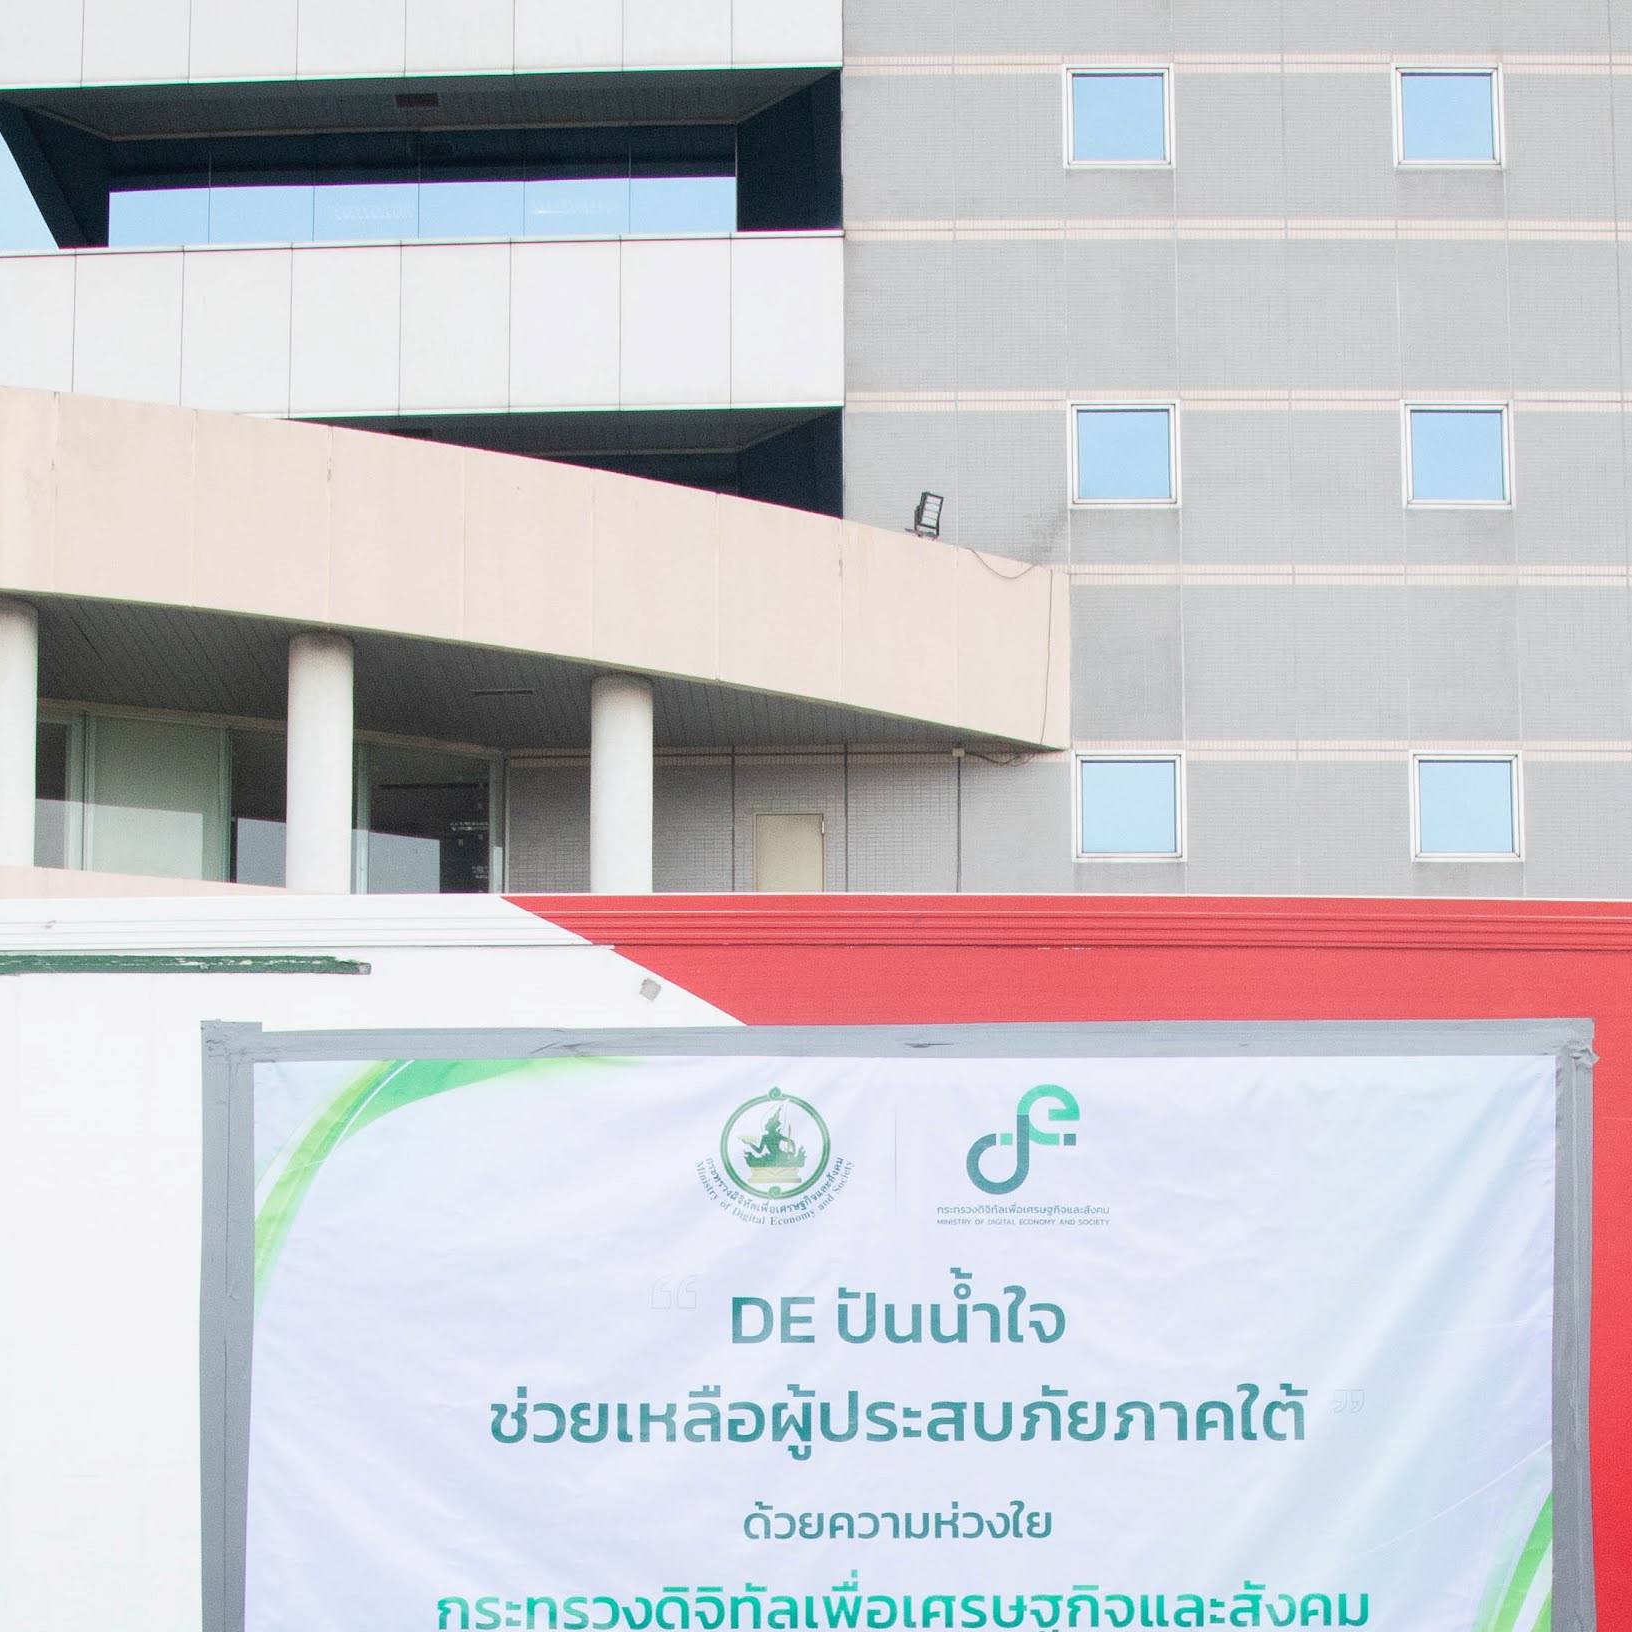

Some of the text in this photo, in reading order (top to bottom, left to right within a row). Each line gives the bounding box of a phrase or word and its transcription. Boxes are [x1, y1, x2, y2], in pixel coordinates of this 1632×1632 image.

[695, 1160, 720, 1202] Ministry
[731, 1206, 766, 1226] Digital
[769, 1209, 817, 1226] Economy
[817, 1193, 835, 1211] and
[832, 1159, 856, 1195] Society
[936, 1218, 972, 1226] MINISTRY
[987, 1218, 1015, 1226] DIGITAL
[1018, 1218, 1056, 1226] ECONOMY
[1059, 1218, 1075, 1226] AND
[1078, 1218, 1110, 1226] SOCIETY
[731, 1267, 1067, 1344] DE ปันน้ำใจ
[490, 1382, 1309, 1461] ช่วยเหลือผู้ประสบภัยภาคใต้
[743, 1500, 1053, 1540] ด้วยความห่วงใย
